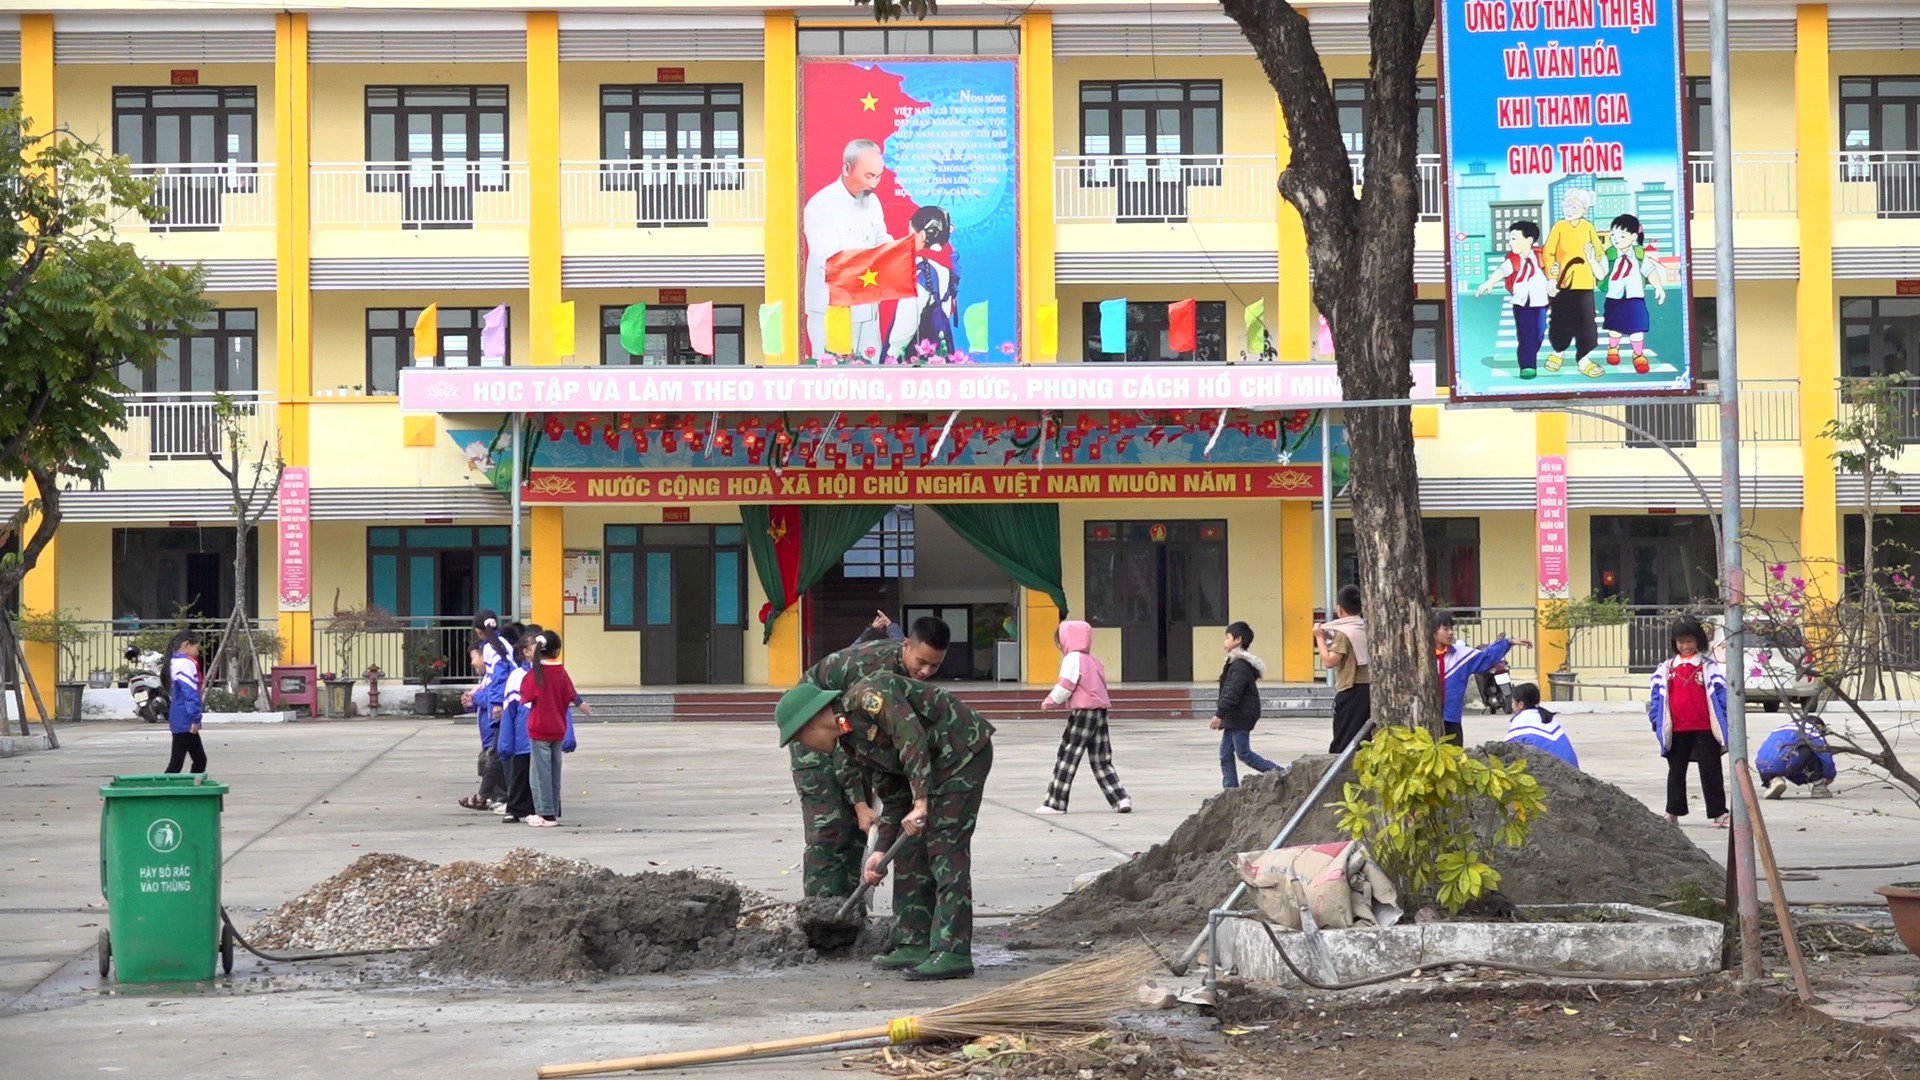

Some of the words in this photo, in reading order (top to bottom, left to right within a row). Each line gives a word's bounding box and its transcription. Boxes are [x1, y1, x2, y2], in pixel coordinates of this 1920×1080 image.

[1504, 43, 1531, 79] VÀ
[1534, 41, 1574, 78] VĂN
[1579, 40, 1620, 76] HÓA
[1498, 97, 1531, 127] KHI
[1535, 95, 1591, 126] THAM
[1597, 94, 1630, 124] GIA
[1508, 145, 1553, 174] GIAO
[1558, 138, 1623, 173] THÔNG
[473, 380, 524, 406] HỌC
[532, 378, 579, 406] TẬP
[588, 377, 621, 402] VÀ
[629, 377, 682, 401] LÀM
[691, 380, 754, 401] THEO
[762, 378, 796, 401] TƯ
[800, 373, 892, 402] TƯỞNG,
[900, 378, 951, 404] ĐẠO
[959, 375, 1018, 402] ĐỨC,
[1027, 377, 1113, 400] PHONG
[1122, 374, 1189, 399] CÁCH
[1198, 370, 1231, 398] HỒ
[1240, 373, 1282, 397] CHÍ
[1291, 376, 1341, 397] MIN
[588, 475, 650, 497] NƯỚC
[658, 475, 720, 499] CỘNG
[728, 473, 773, 495] HOÀ
[780, 473, 811, 495] XÃ
[818, 473, 856, 498] HỘI
[864, 471, 908, 495] CHỦ
[916, 472, 986, 494] NGHĨA
[993, 472, 1040, 497] VIỆT
[1047, 474, 1100, 493] NAM
[1108, 471, 1176, 493] MUÔN
[1184, 471, 1235, 492] NĂM
[1245, 474, 1252, 492] !
[140, 880, 160, 892] VÀO
[161, 879, 191, 892] THÙNG
[172, 864, 191, 877] RÁC
